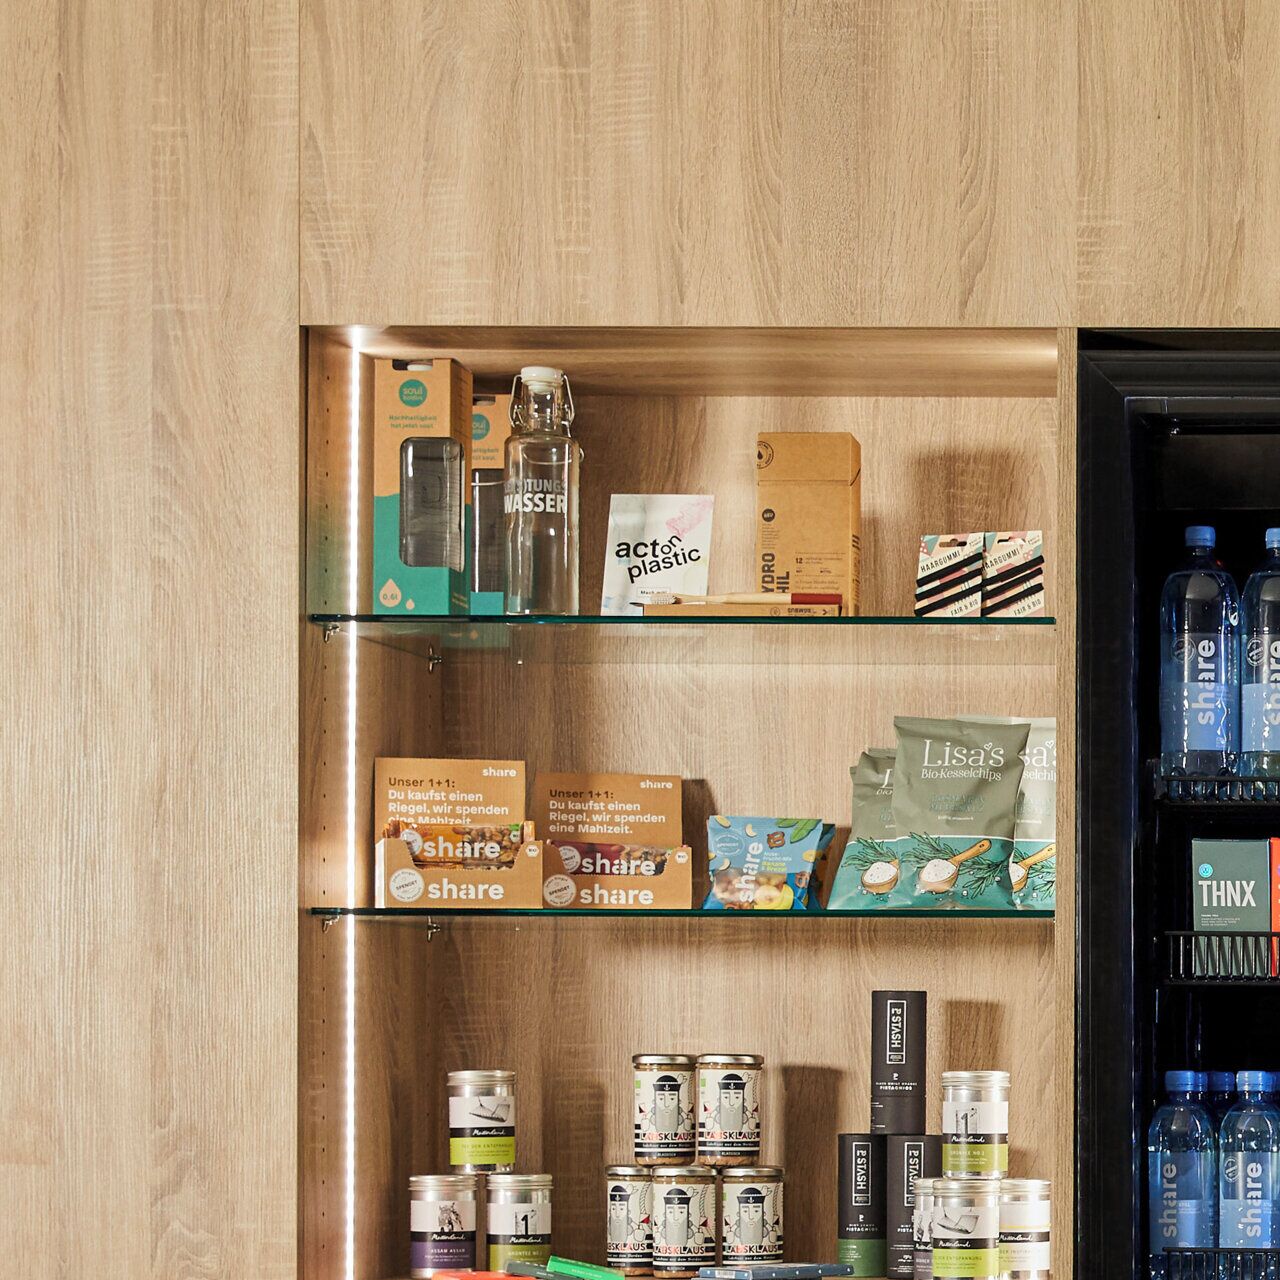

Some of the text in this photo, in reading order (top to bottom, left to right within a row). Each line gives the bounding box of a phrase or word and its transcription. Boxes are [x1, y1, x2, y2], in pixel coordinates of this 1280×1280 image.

[504, 494, 567, 514] WASSER
[615, 535, 682, 559] act on
[627, 547, 701, 584] plastic
[920, 550, 961, 573] HAARGUMMI
[762, 553, 776, 593] YDRO
[1192, 639, 1215, 725] share
[922, 739, 1004, 767] Lisa's
[388, 777, 456, 788] Unser 1+1:
[482, 767, 517, 777] share
[921, 767, 1002, 782] Bio-Kesselchips
[550, 789, 614, 799] Unser 1+1:
[640, 780, 673, 789] share
[388, 790, 483, 801] Du kaufst einen
[549, 800, 641, 811] Du kaufst einen
[388, 803, 509, 816] Riegel, wir spenden
[549, 812, 666, 824] Riegel, wir spenden
[549, 823, 633, 834] eine Mahlzeit.
[423, 836, 500, 858] share
[581, 853, 656, 875] share
[735, 842, 763, 902] share
[427, 878, 504, 900] share
[580, 884, 654, 905] share
[1198, 880, 1257, 907] THNX
[640, 1131, 693, 1141] LABSKLAUS
[704, 1131, 757, 1140] LABSKLAUS
[1158, 1162, 1177, 1238] share
[1240, 1161, 1262, 1238] share
